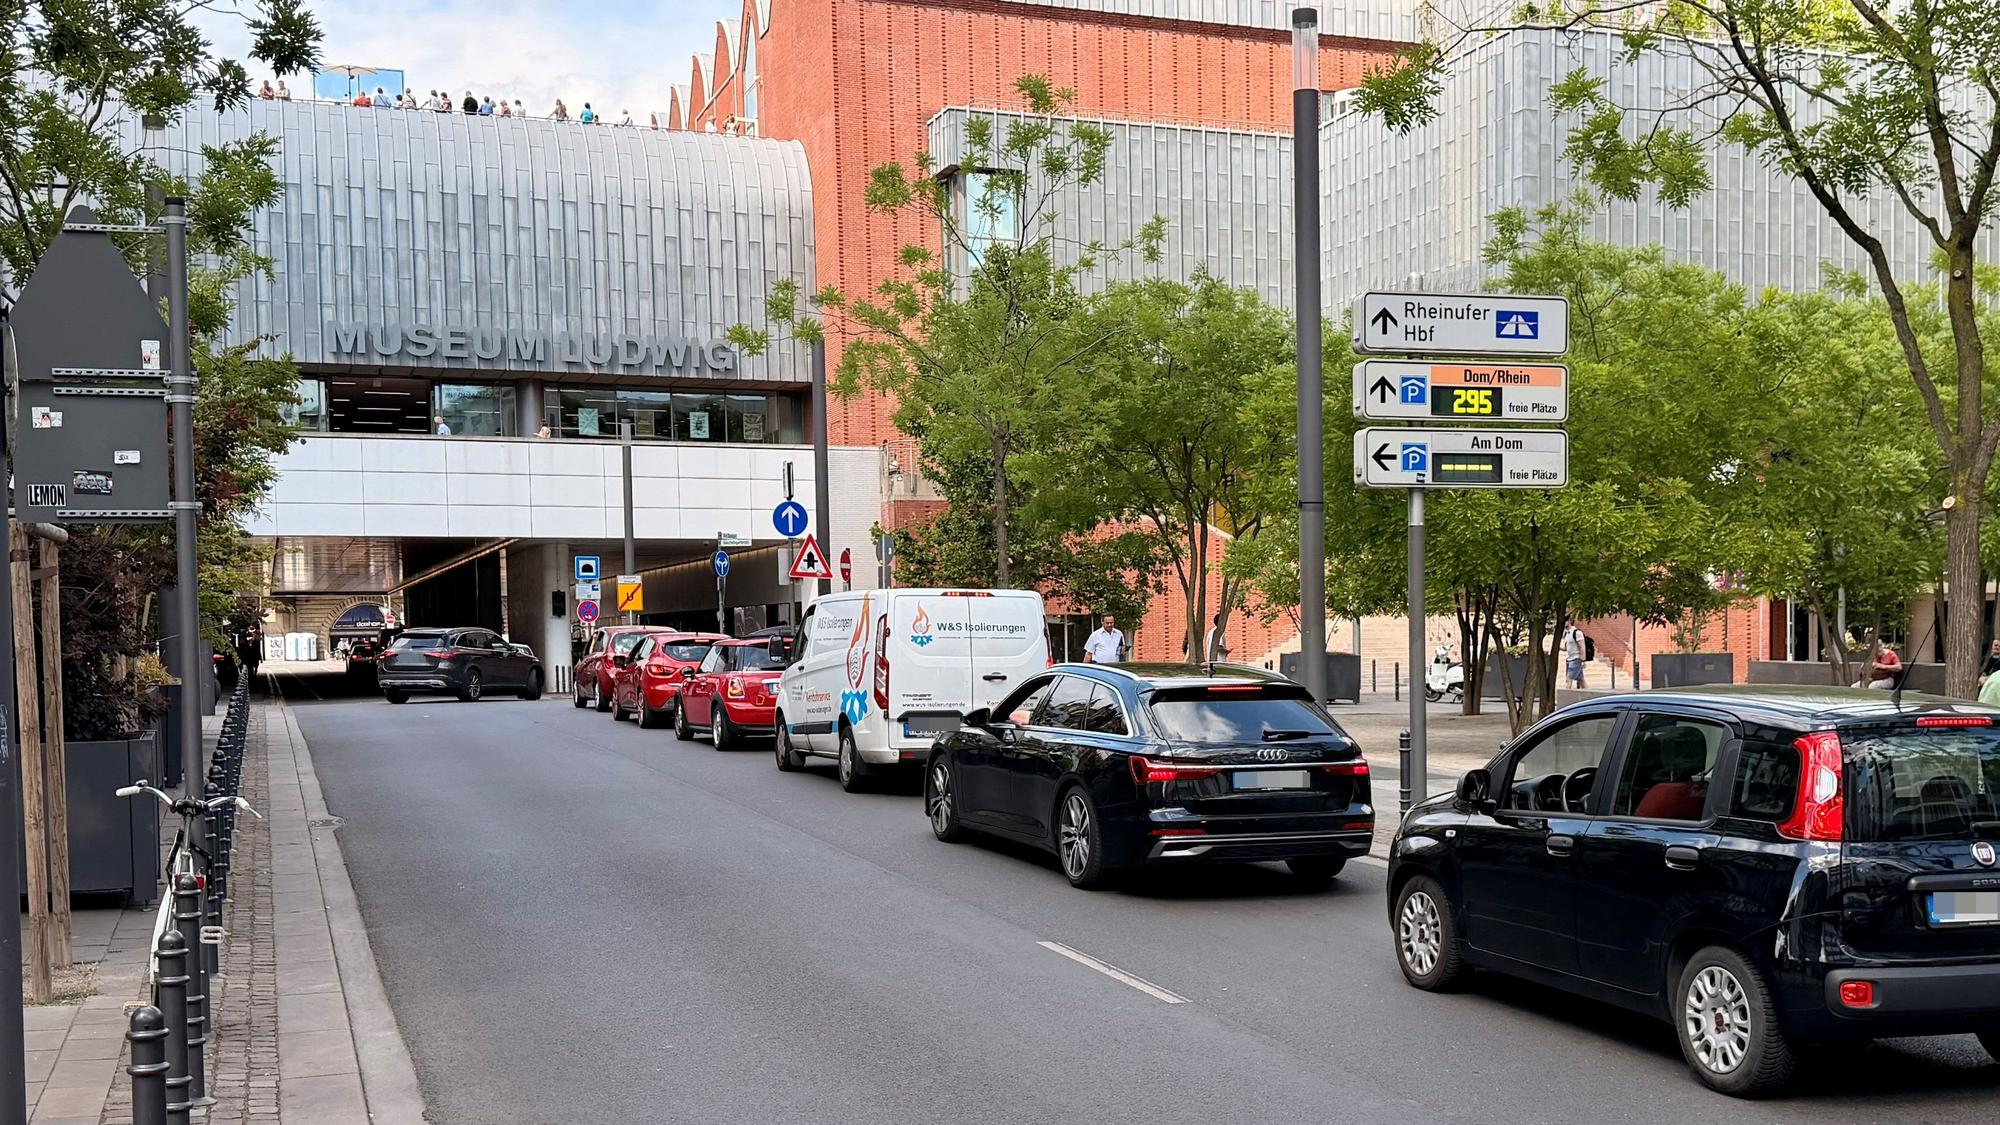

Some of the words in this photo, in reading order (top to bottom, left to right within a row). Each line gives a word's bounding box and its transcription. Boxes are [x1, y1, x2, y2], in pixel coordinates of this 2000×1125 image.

[1404, 301, 1490, 320] Rheinufer
[1404, 325, 1434, 342] Hbf
[328, 323, 546, 362] MUSEUM
[561, 337, 735, 370] LUDWIG
[1464, 369, 1530, 384] Dom/Rhein
[1453, 389, 1492, 414] 295
[1509, 402, 1528, 413] freie
[1531, 402, 1557, 414] Plätze
[1471, 437, 1491, 449] Am
[1495, 437, 1523, 449] Dom
[1510, 469, 1528, 480] freie
[1532, 469, 1557, 480] Plätze
[29, 485, 65, 506] LEMON
[937, 622, 962, 631] W&S
[965, 622, 1026, 634] Isolierungen
